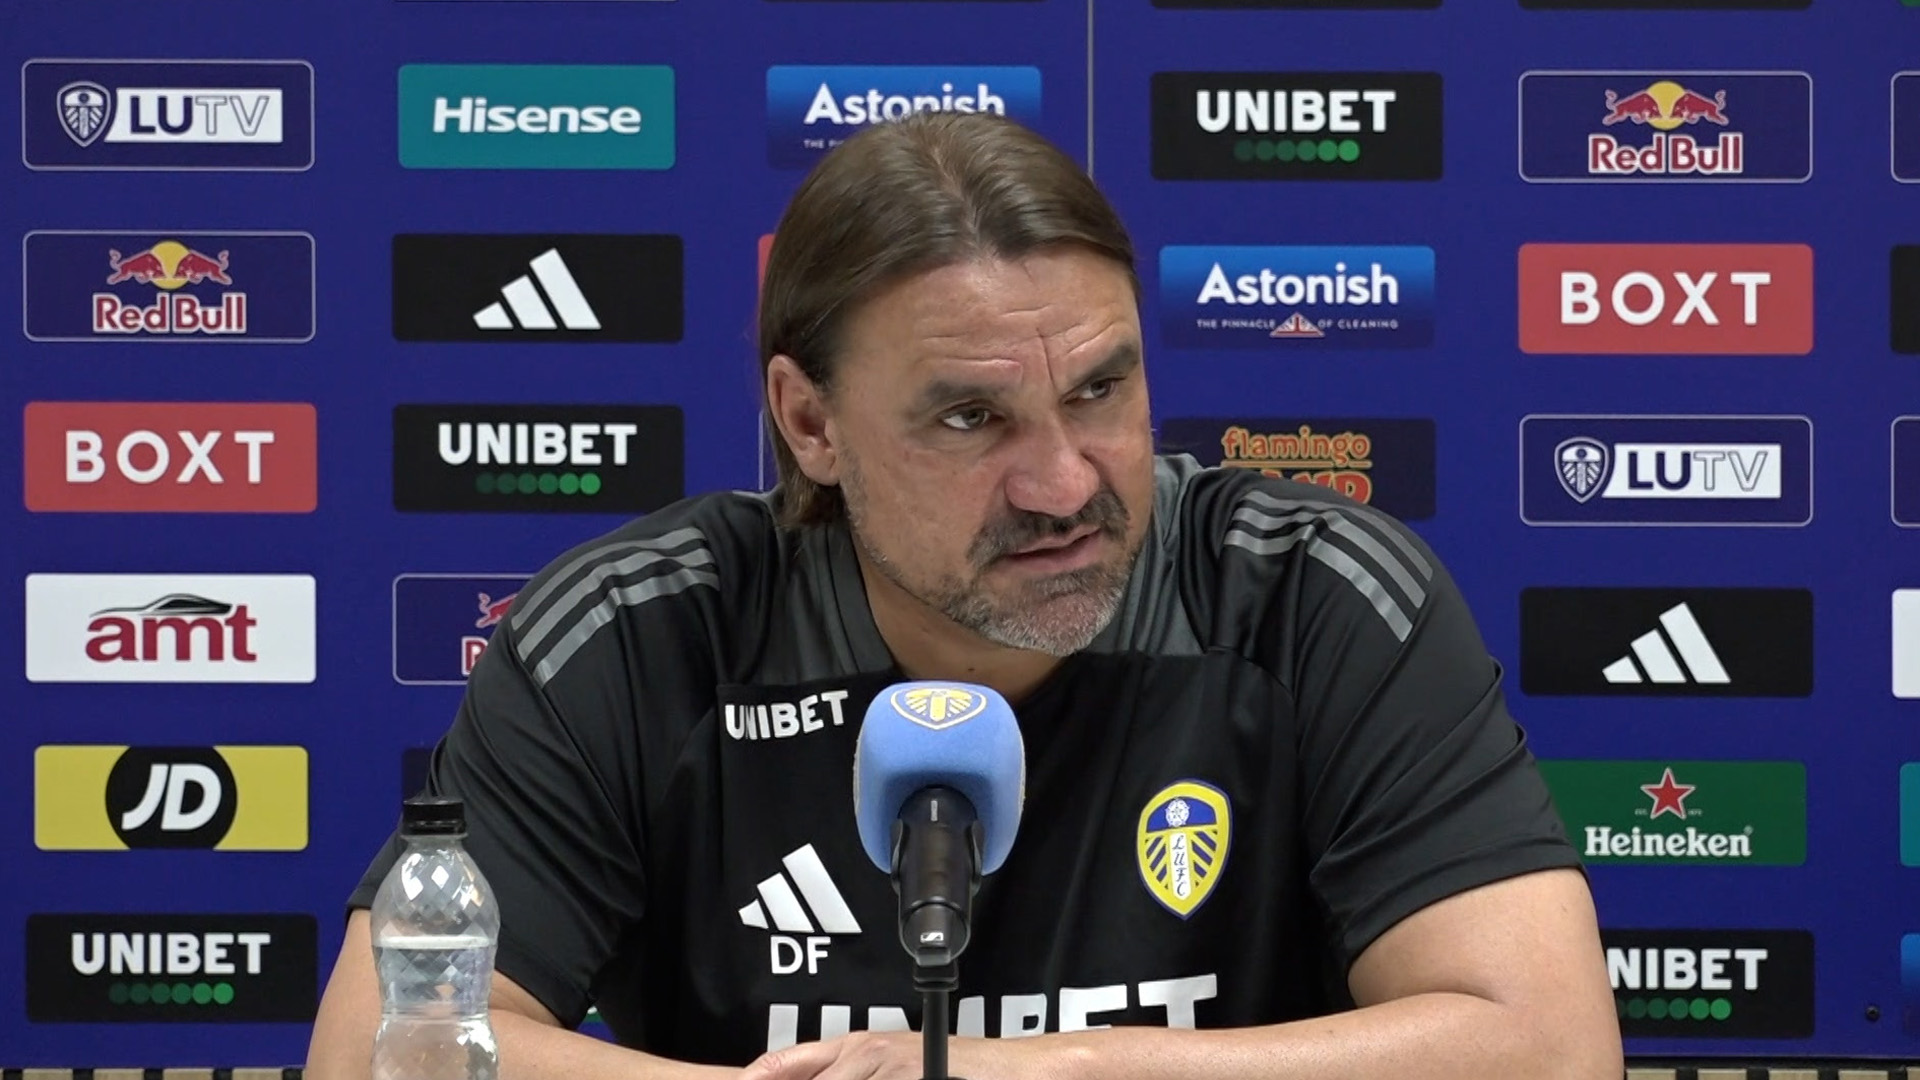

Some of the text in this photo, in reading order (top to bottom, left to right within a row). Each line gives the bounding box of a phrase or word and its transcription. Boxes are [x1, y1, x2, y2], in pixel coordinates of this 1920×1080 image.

[129, 95, 270, 135] LUTV
[433, 97, 641, 133] Hisense
[1196, 90, 1396, 133] UNIBET
[803, 139, 825, 149] THE
[1588, 134, 1743, 174] Red Bull
[1197, 261, 1399, 305] Astonish
[1561, 271, 1771, 325] BOXT
[92, 293, 247, 333] Red Bull
[1197, 318, 1399, 330] THE PINNACLE OF CLEANING
[66, 430, 275, 483] BOXT
[438, 423, 637, 465] UNIBET
[1221, 425, 1371, 467] flamingo
[1626, 450, 1768, 491] LUTV
[85, 605, 257, 663] amt
[724, 689, 849, 741] UNIBET
[121, 764, 222, 830] JD
[1584, 826, 1752, 857] Heineken
[72, 933, 271, 974] UNIBET
[770, 935, 831, 975] DF
[1606, 948, 1768, 990] NIBET
[767, 974, 1217, 1053] UIBET
